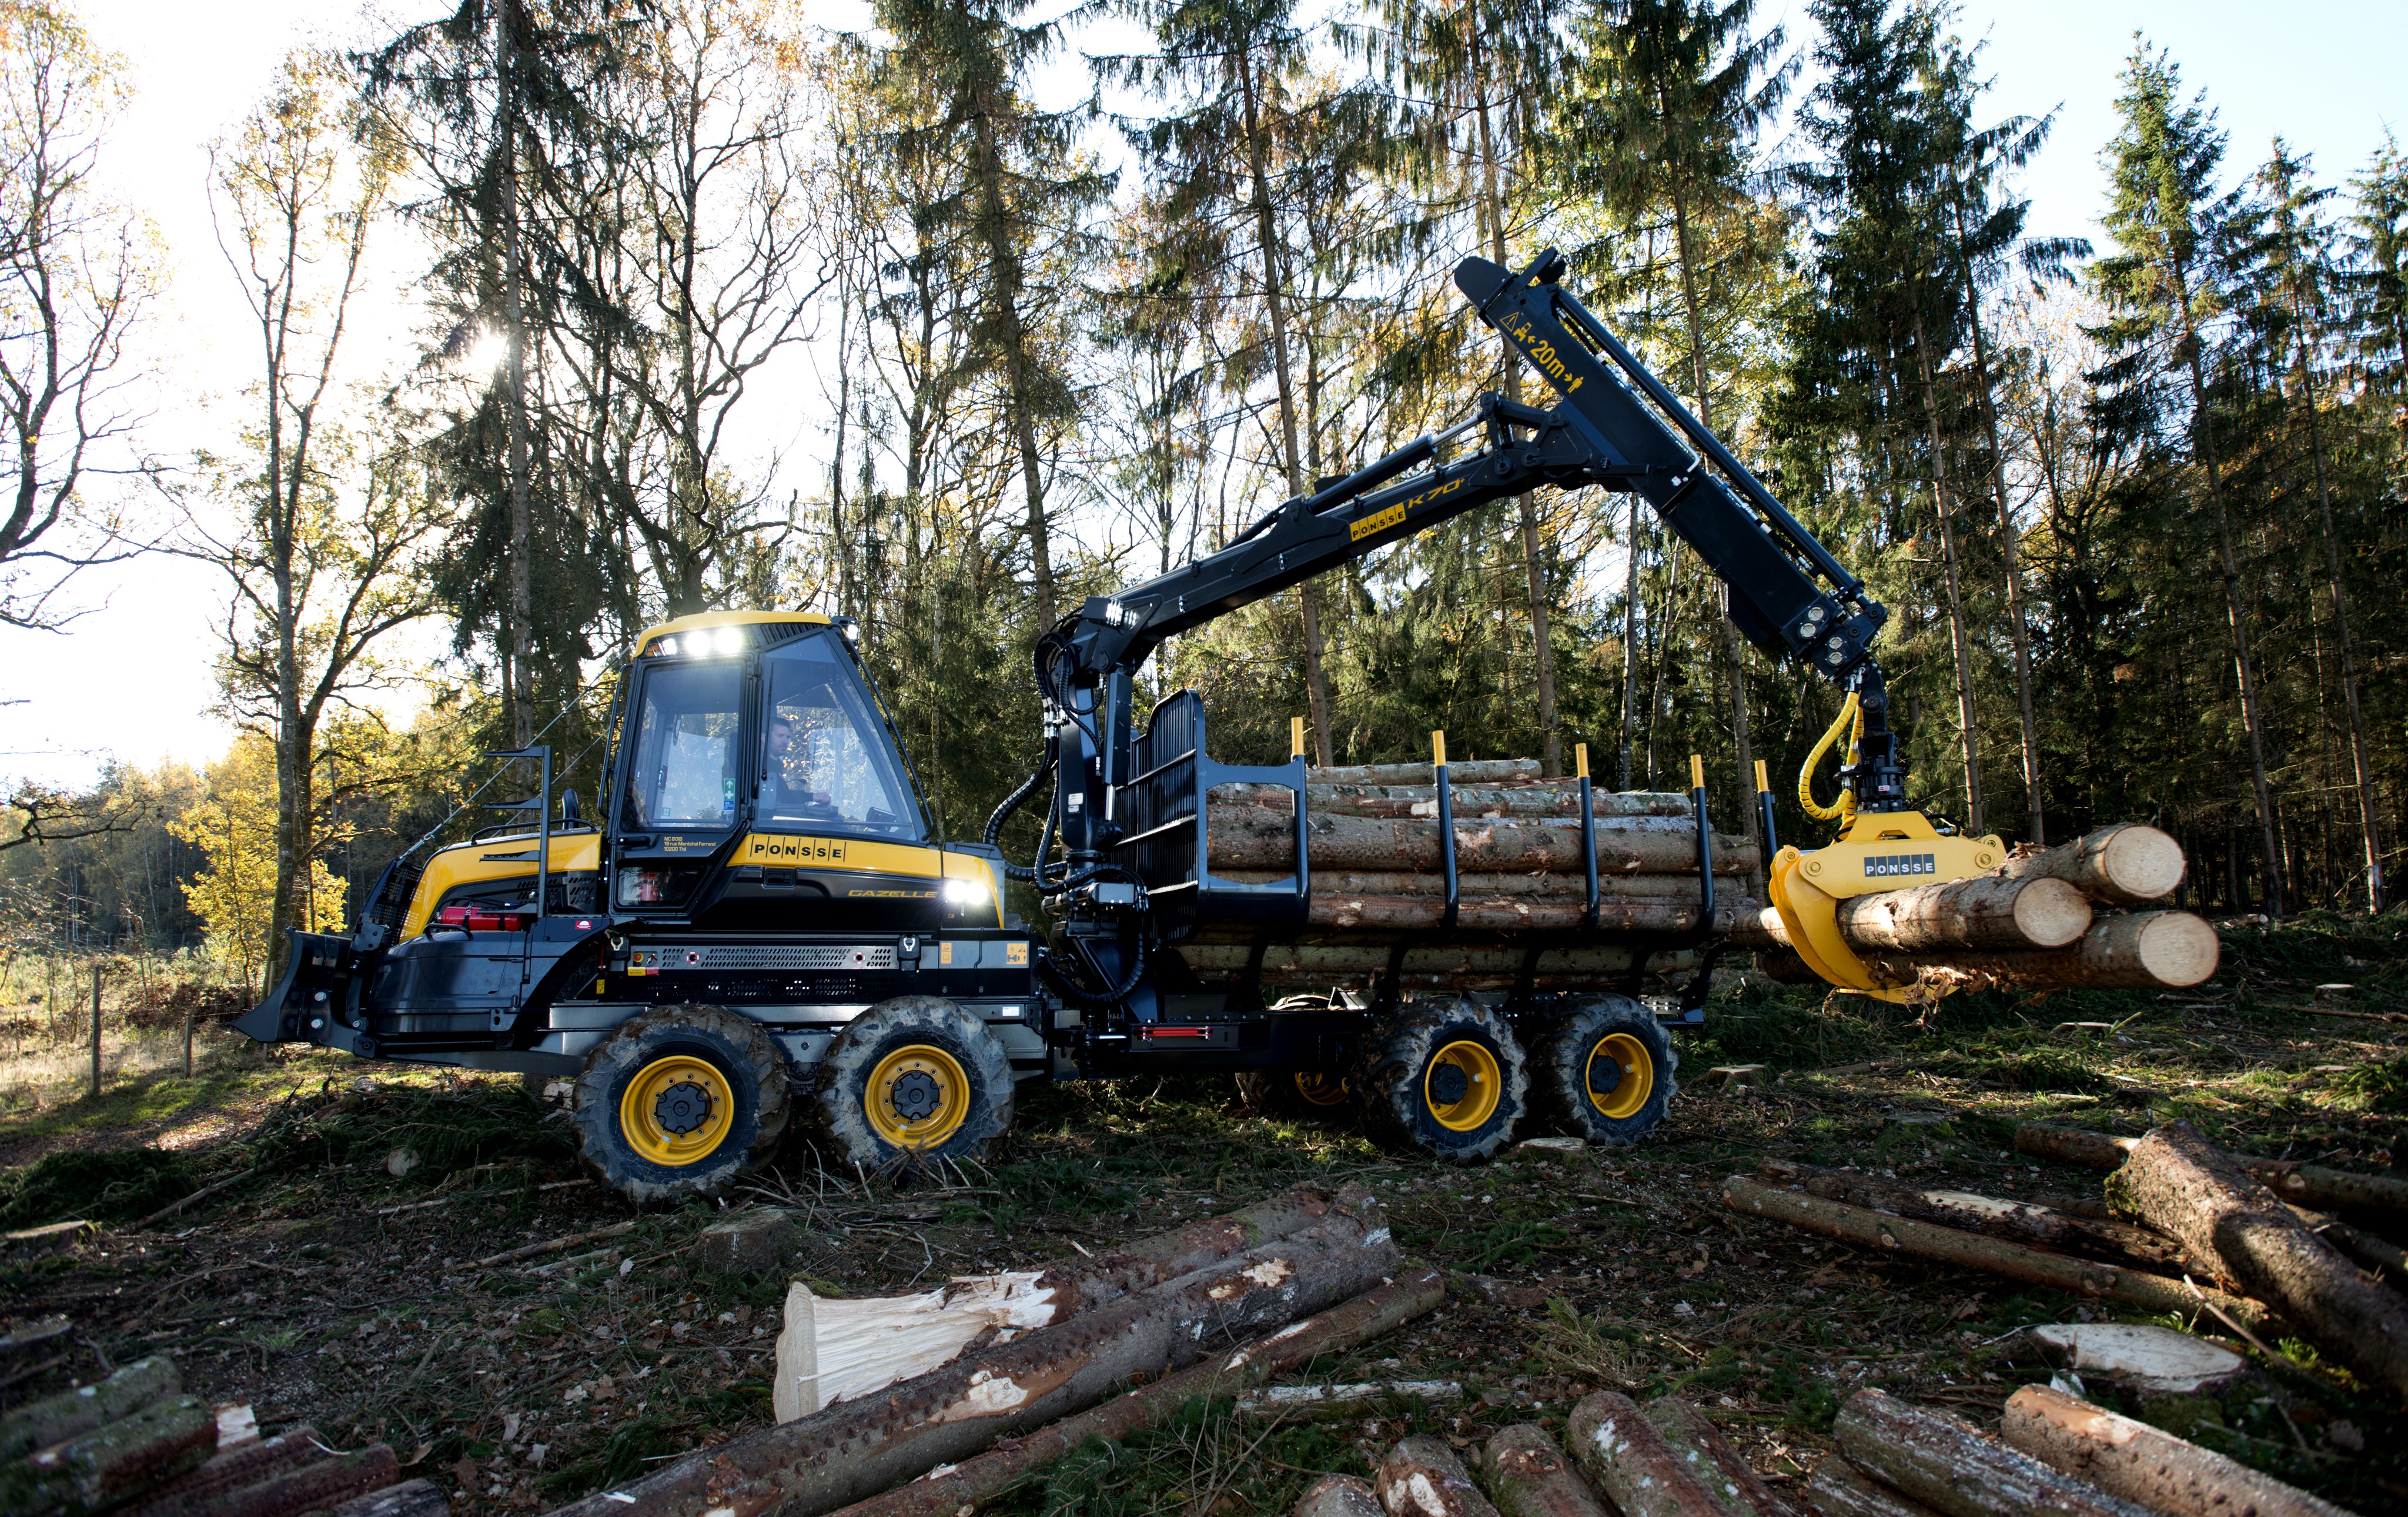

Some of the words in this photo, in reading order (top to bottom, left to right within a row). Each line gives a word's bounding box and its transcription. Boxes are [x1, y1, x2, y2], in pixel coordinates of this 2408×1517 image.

[1530, 339, 1565, 379] 20m
[1352, 511, 1404, 538] PONSSE
[754, 844, 842, 858] PONSSE
[1866, 863, 1934, 874] PONSSE
[848, 890, 938, 898] GAZELLE
